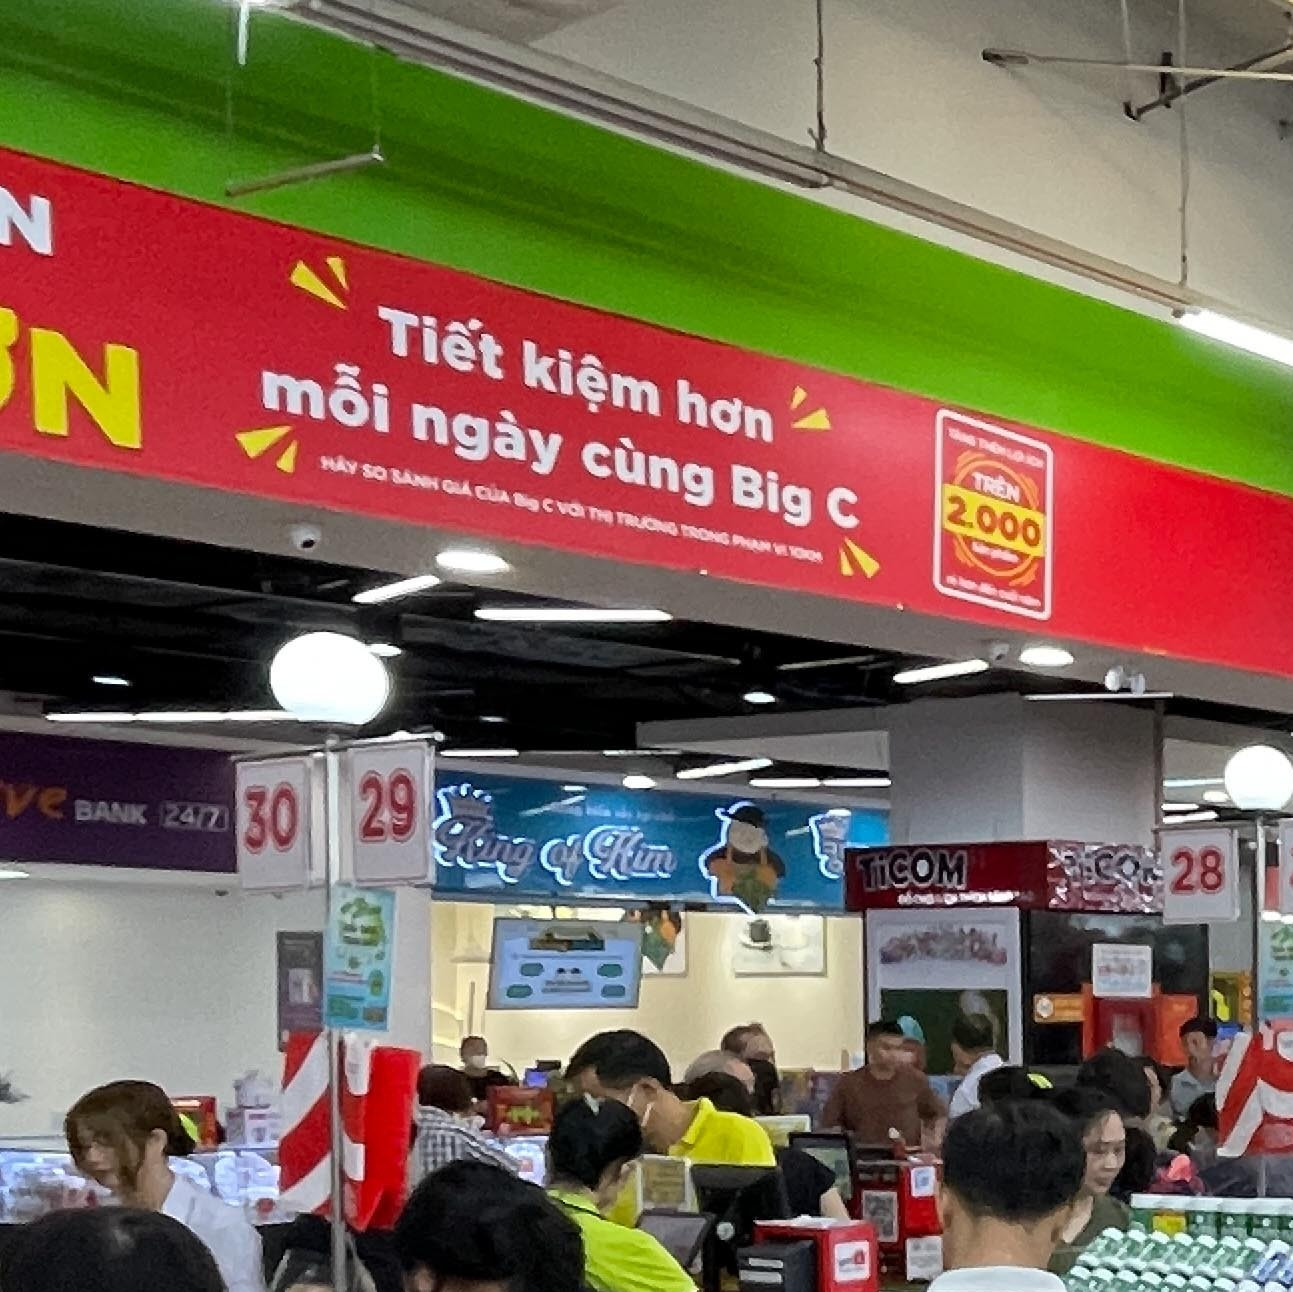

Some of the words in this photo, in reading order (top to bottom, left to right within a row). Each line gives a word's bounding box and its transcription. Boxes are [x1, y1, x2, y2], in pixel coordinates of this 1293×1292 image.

[377, 304, 505, 381] Tiết
[522, 338, 662, 417] kiệm
[676, 379, 774, 443] hơn
[261, 362, 391, 434] mỗi
[411, 400, 562, 476] ngày
[581, 437, 715, 508] cùng
[731, 463, 812, 528] Big
[826, 486, 862, 530] C
[973, 472, 1020, 503] TRÊN
[948, 496, 1041, 547] 2.000
[75, 800, 148, 825] BANK
[164, 803, 223, 830] 24/7
[243, 781, 299, 855] 30
[358, 768, 418, 843] 29
[1170, 847, 1225, 895] 28
